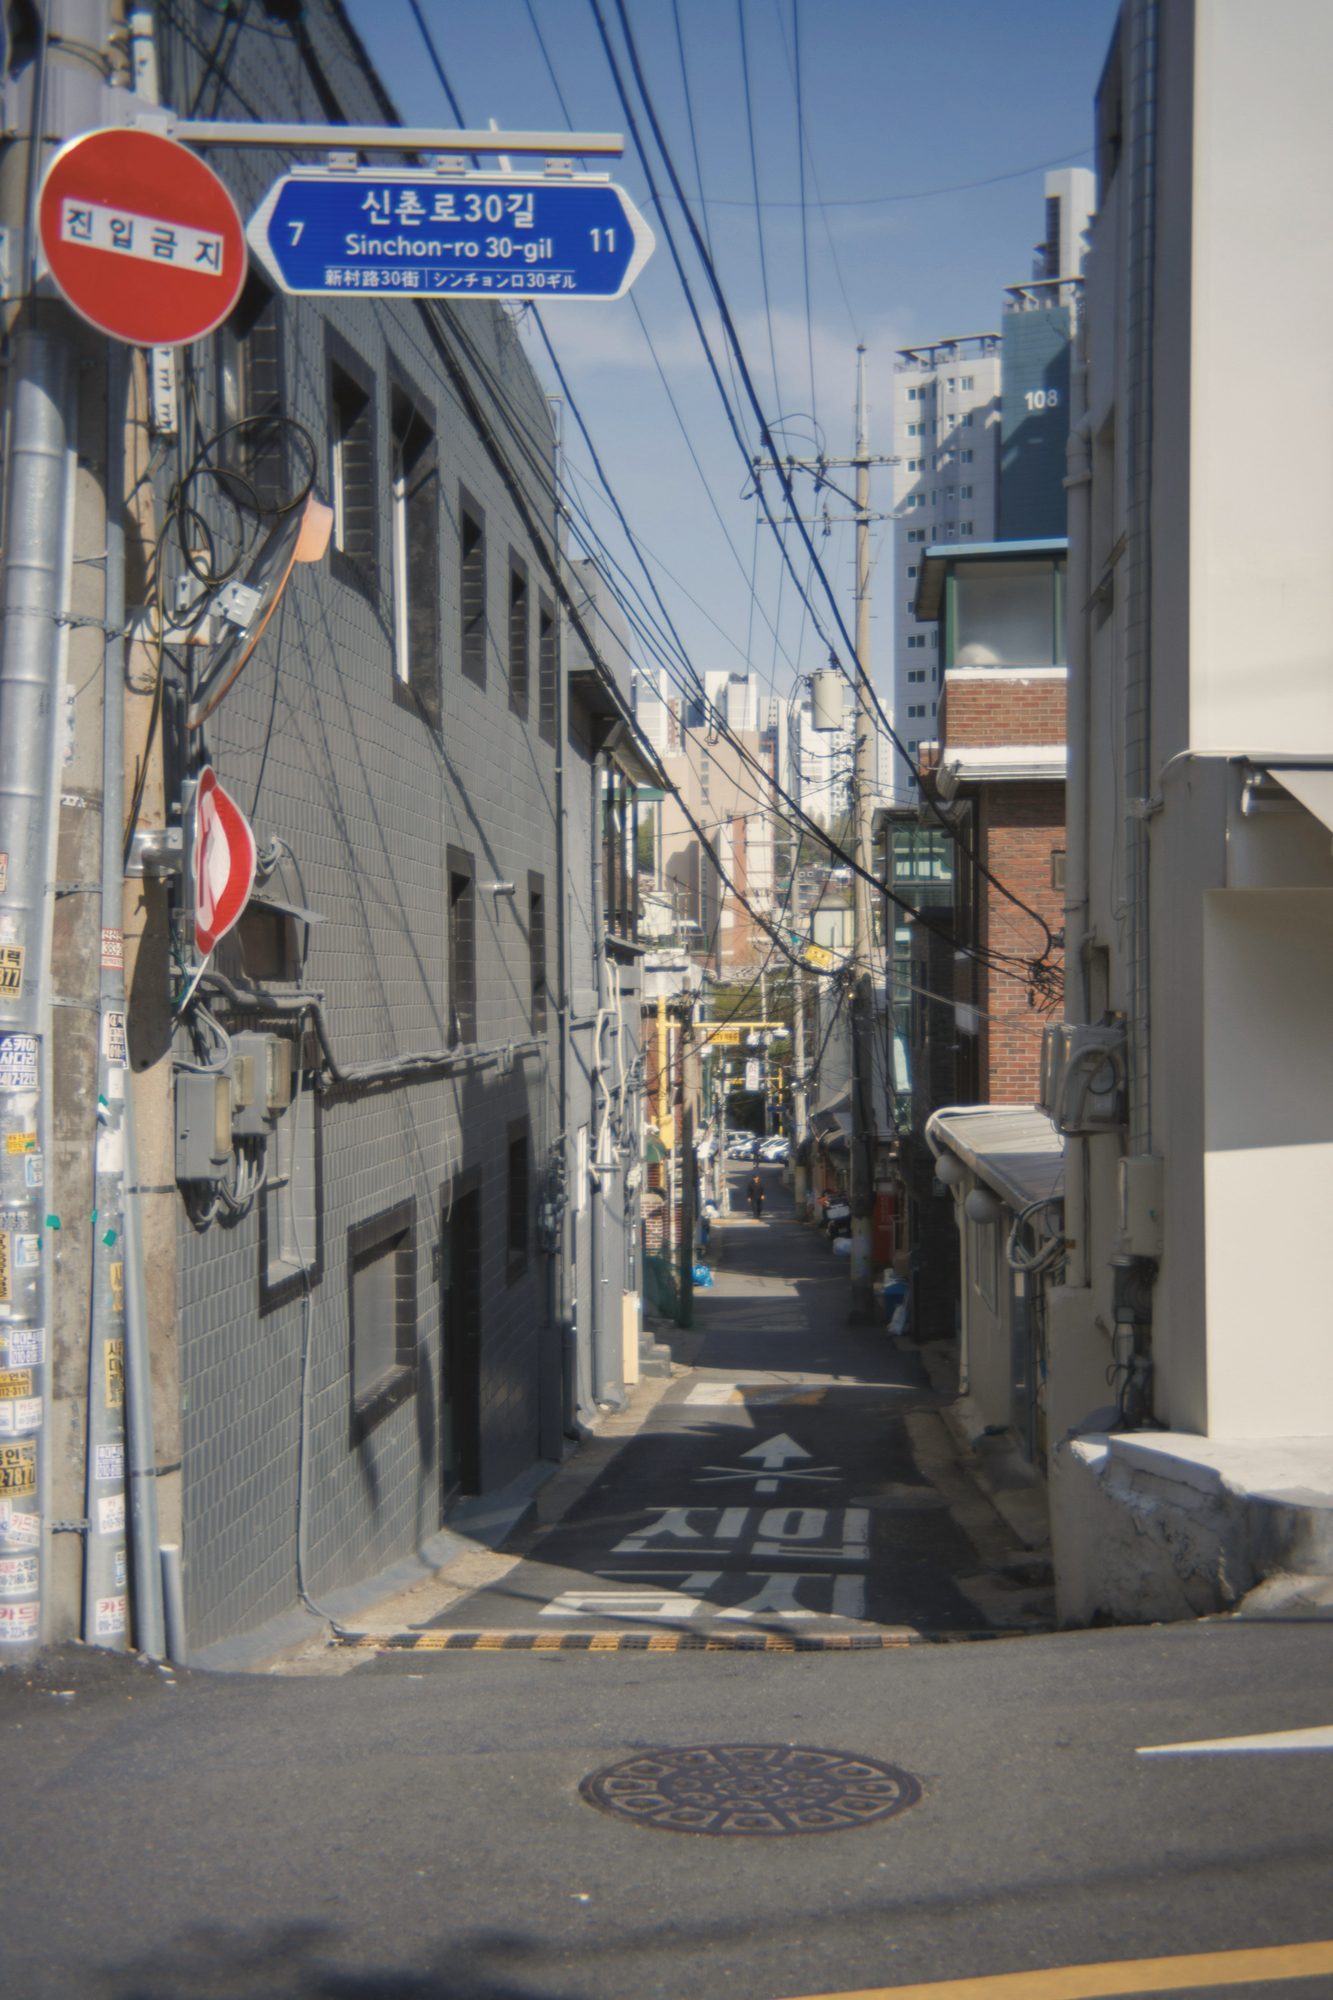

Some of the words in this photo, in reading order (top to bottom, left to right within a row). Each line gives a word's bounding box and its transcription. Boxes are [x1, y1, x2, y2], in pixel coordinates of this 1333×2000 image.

[360, 189, 534, 229] 신촌로30길
[63, 206, 221, 271] 진입금지
[287, 221, 305, 247] 7
[589, 227, 615, 253] 11
[345, 233, 479, 258] Sinchon-ro
[485, 236, 552, 263] 30-gil
[324, 268, 419, 289] 新村路30街
[1024, 389, 1059, 411] 108
